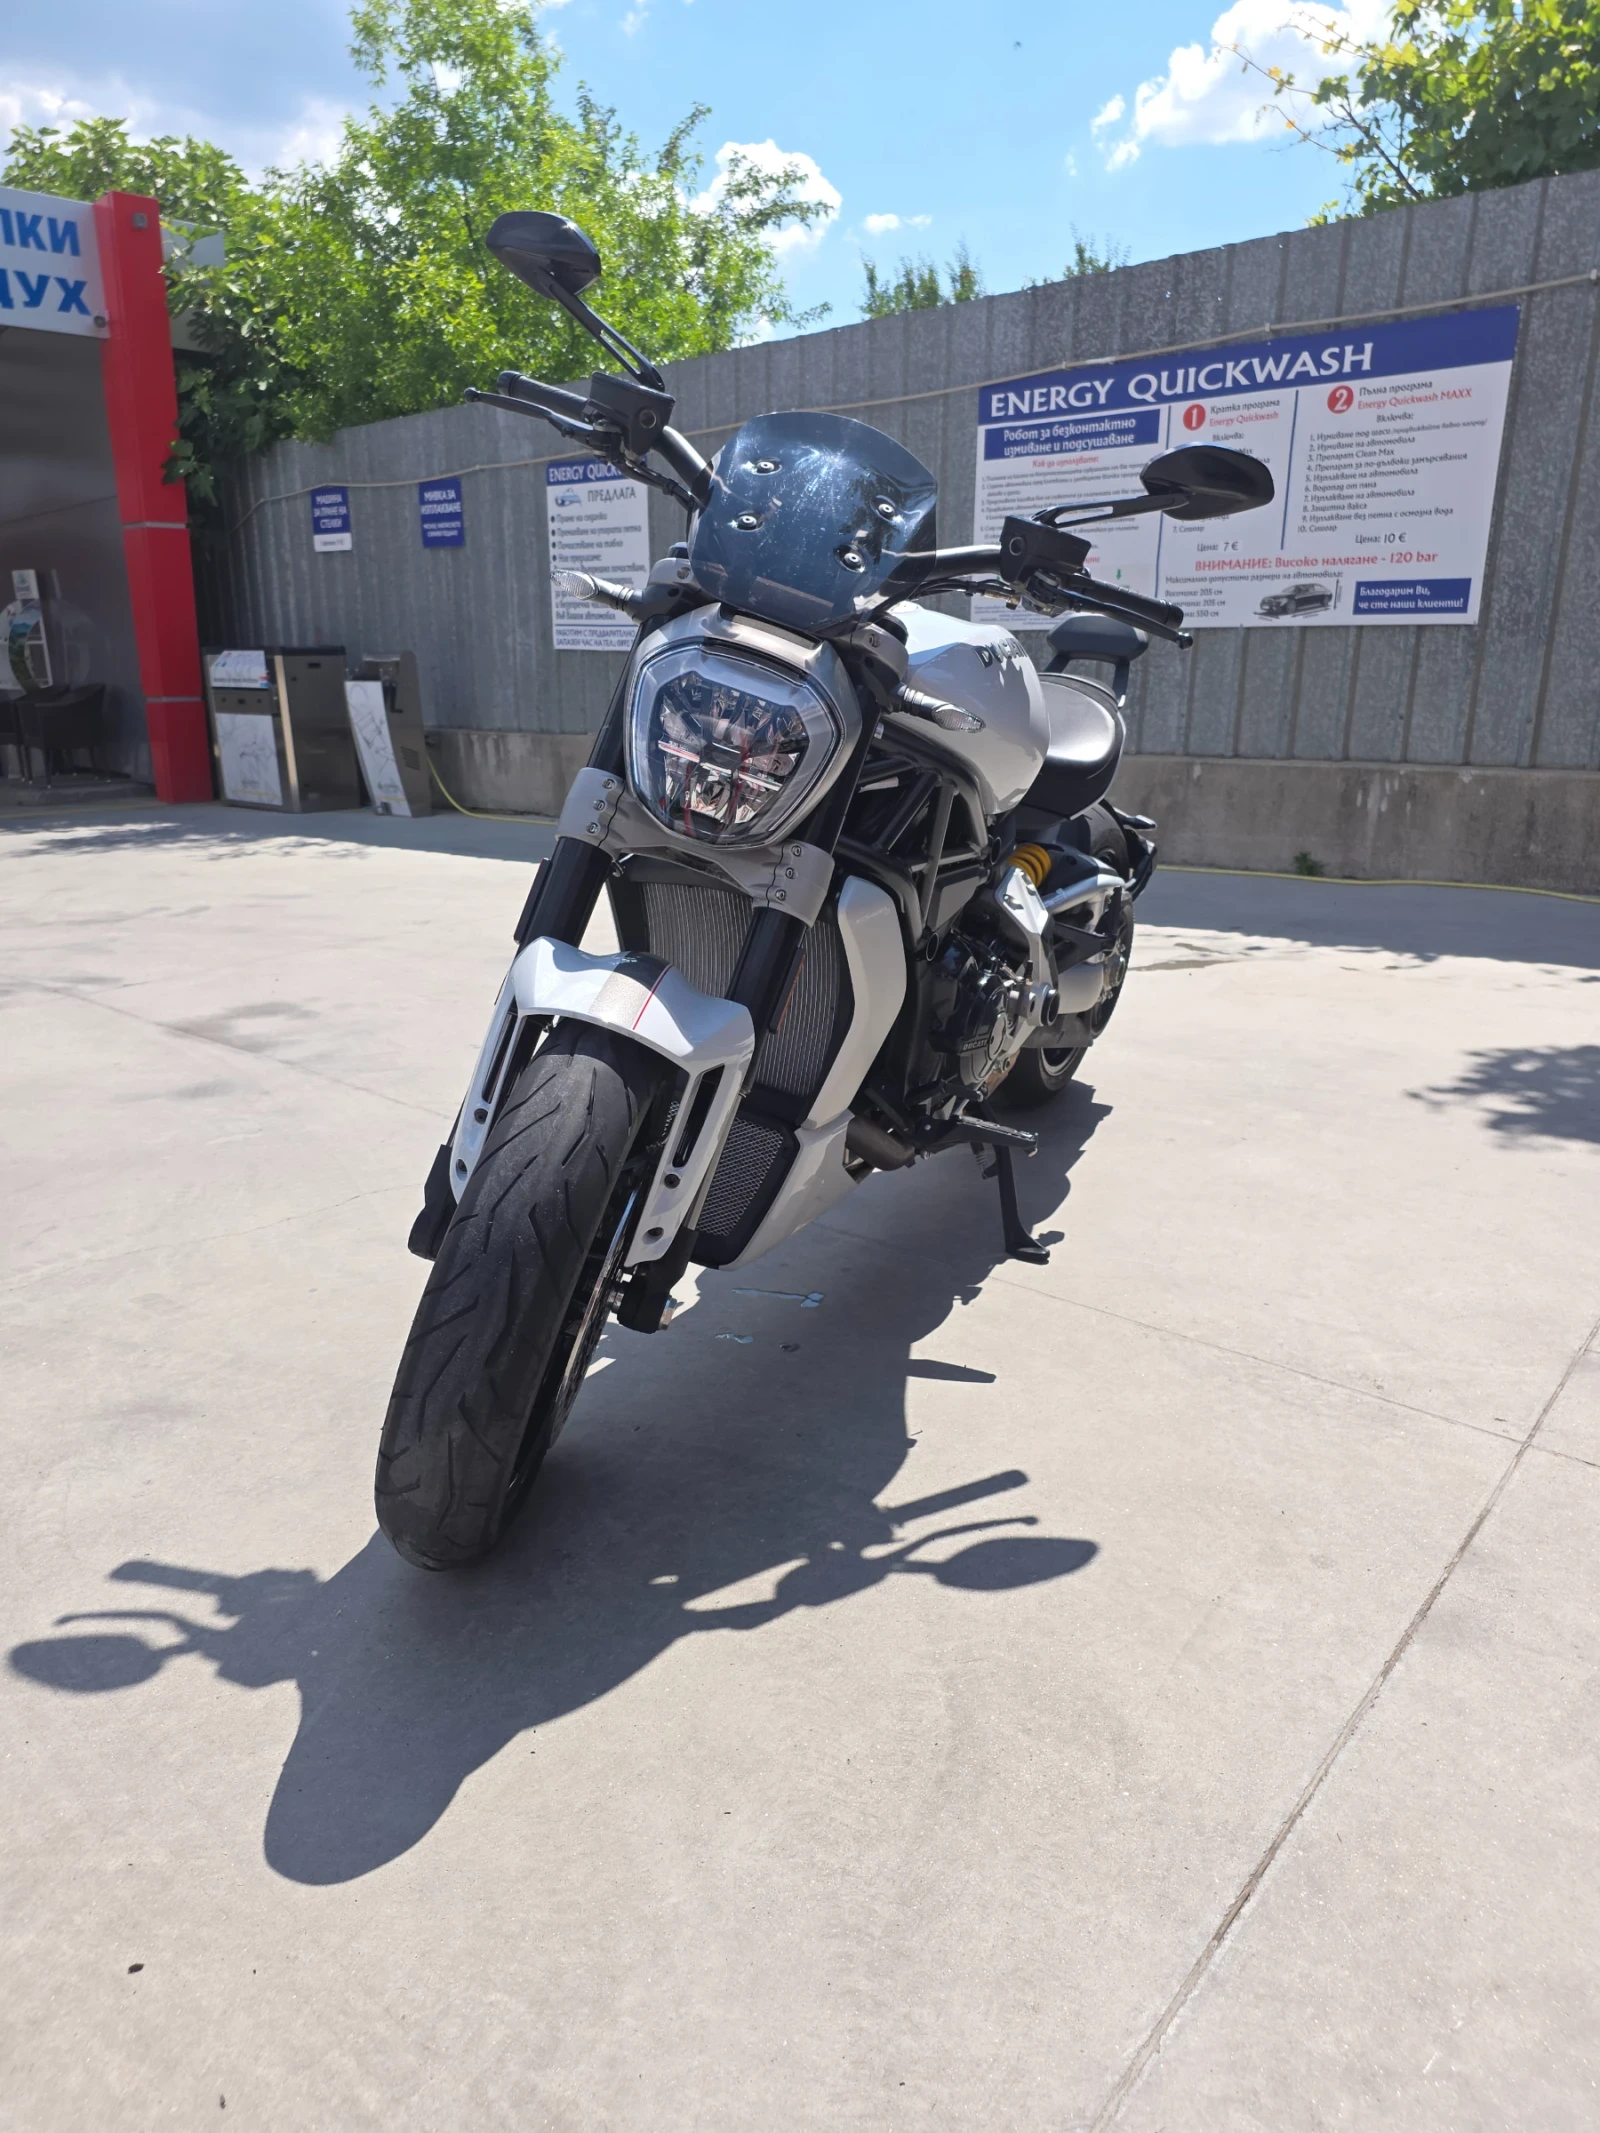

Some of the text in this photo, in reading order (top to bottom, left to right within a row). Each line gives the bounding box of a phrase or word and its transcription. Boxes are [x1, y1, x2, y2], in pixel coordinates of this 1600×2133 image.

[990, 342, 1374, 418] ENERGY QUICKWASH
[1358, 380, 1433, 397] Пълна програма
[1242, 398, 1281, 411] програма
[1357, 387, 1473, 411] Energy Quickwash MAXX
[1209, 411, 1279, 428] Energy Quickwash
[1003, 418, 1137, 442] Робот за безконтактно
[1003, 432, 1135, 458] измиване и подсушаване
[548, 463, 622, 483] ENERGY QUICK
[587, 486, 637, 504] ПРЕДЛАГА
[1197, 541, 1240, 553] Цена: 7 €
[1354, 532, 1407, 545] Цена: 10 €
[1194, 557, 1273, 571] ВНИМАНИЕ:
[1275, 555, 1319, 568] Високо
[1320, 553, 1379, 567] налягане
[1389, 551, 1414, 563] 120
[1415, 550, 1439, 563] bar
[1199, 588, 1212, 596] 205
[1359, 585, 1431, 598] Благодарим Ви,
[1202, 599, 1215, 607] 205
[1358, 597, 1464, 609] че сте наши клиенти!
